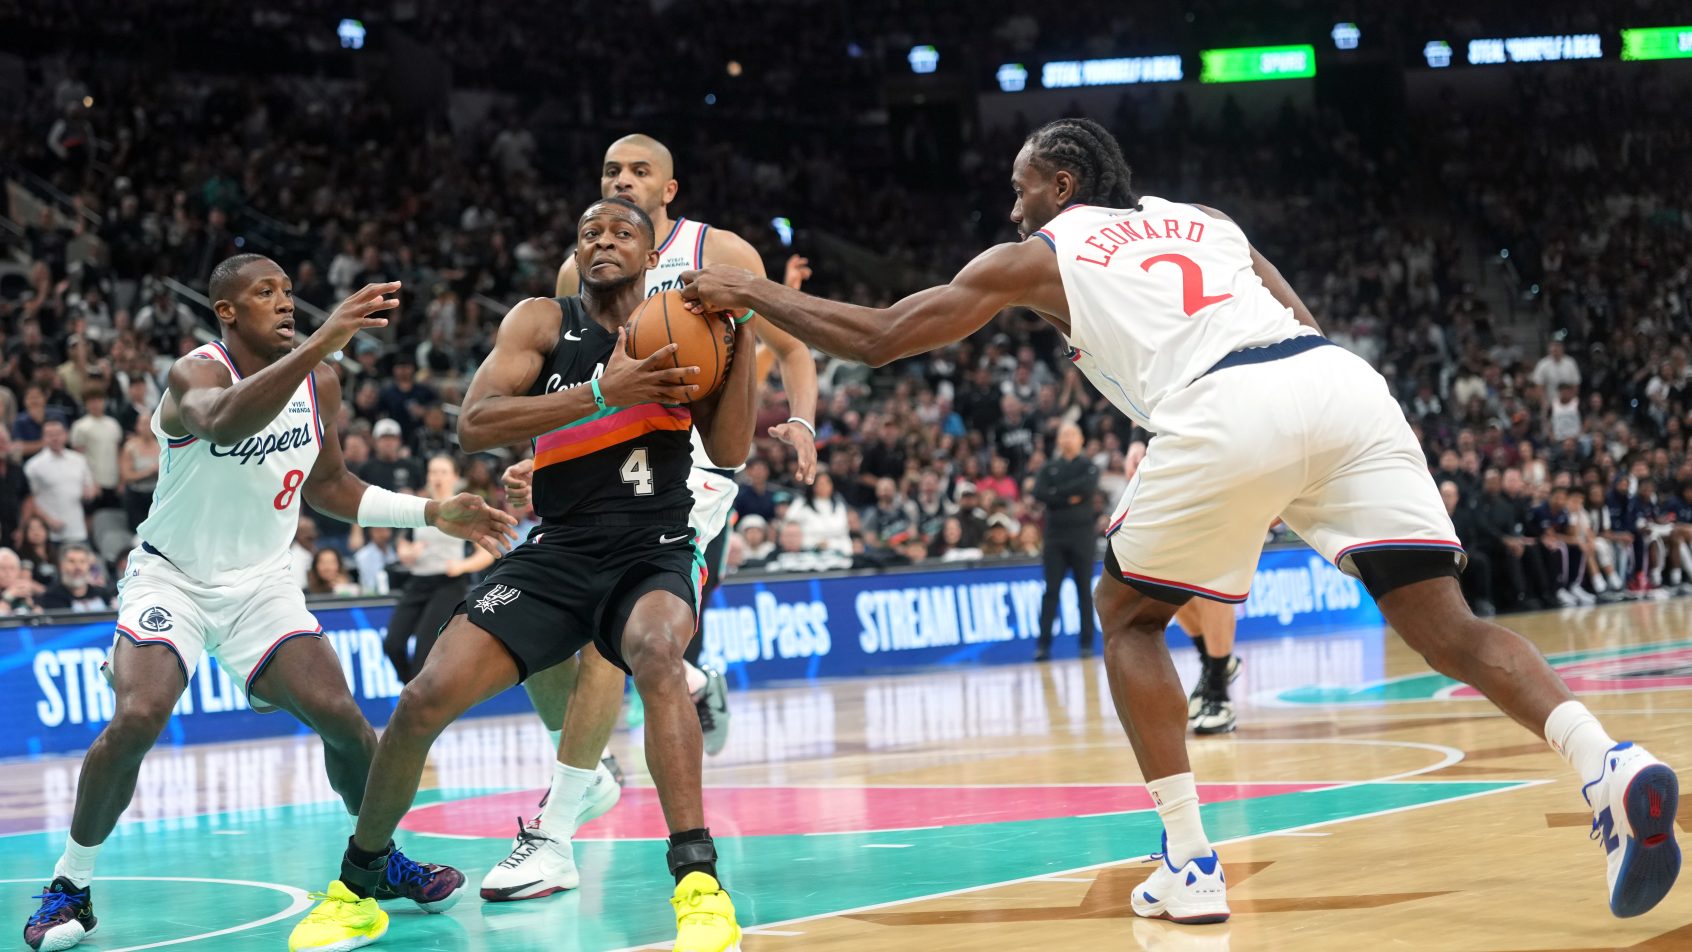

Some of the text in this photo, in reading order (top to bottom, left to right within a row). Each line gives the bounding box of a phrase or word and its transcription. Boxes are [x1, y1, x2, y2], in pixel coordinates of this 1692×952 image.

[1076, 219, 1205, 268] LEONARD
[1140, 253, 1234, 317] 2
[273, 469, 304, 511] 8
[619, 446, 655, 497] 4
[697, 590, 831, 675] gue Pass
[855, 584, 959, 653] STREAM
[958, 581, 1014, 642] LIKE
